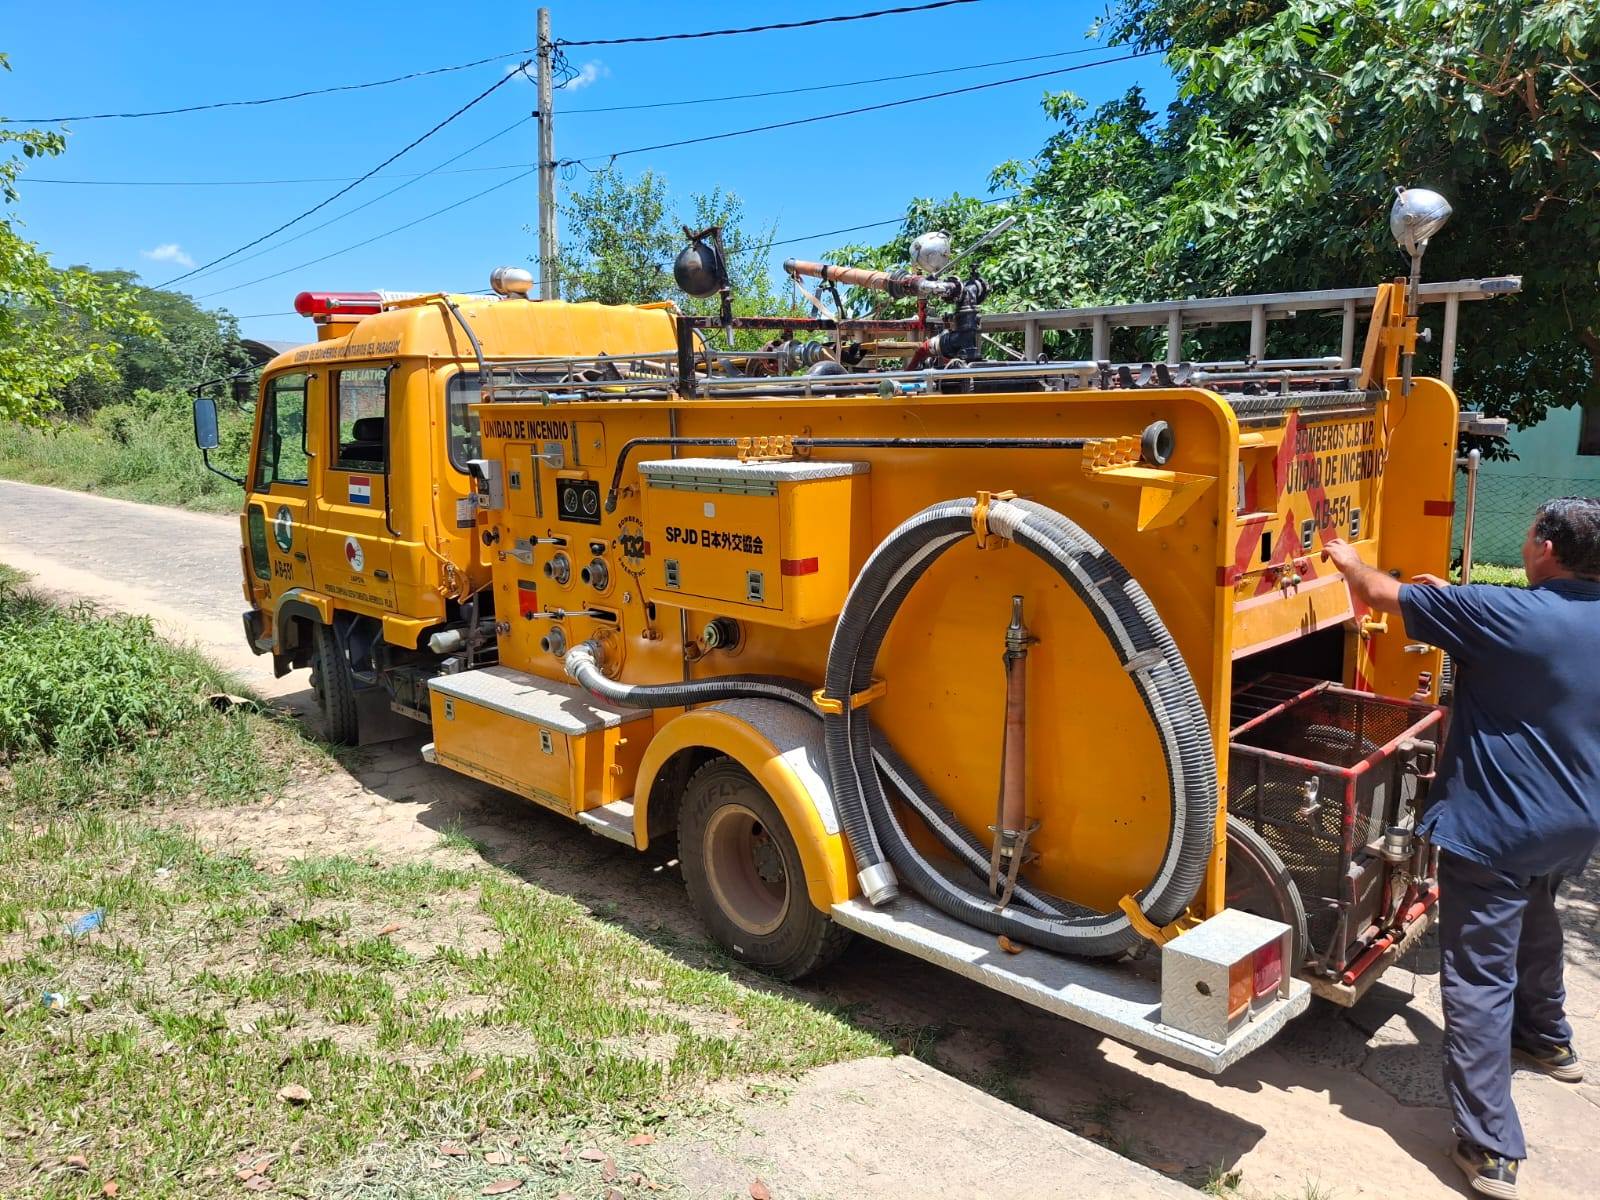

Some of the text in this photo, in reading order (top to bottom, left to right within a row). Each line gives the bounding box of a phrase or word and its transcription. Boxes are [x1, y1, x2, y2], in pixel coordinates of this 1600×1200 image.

[483, 420, 569, 440] UNIDAD DE INCENDIO
[1295, 423, 1344, 455] BOMBEROS
[1286, 448, 1384, 495] UNIDAD DE INCENDIO
[620, 534, 645, 559] 132
[665, 526, 763, 555] SPJD 日本外交協会
[274, 559, 295, 581] AB-551
